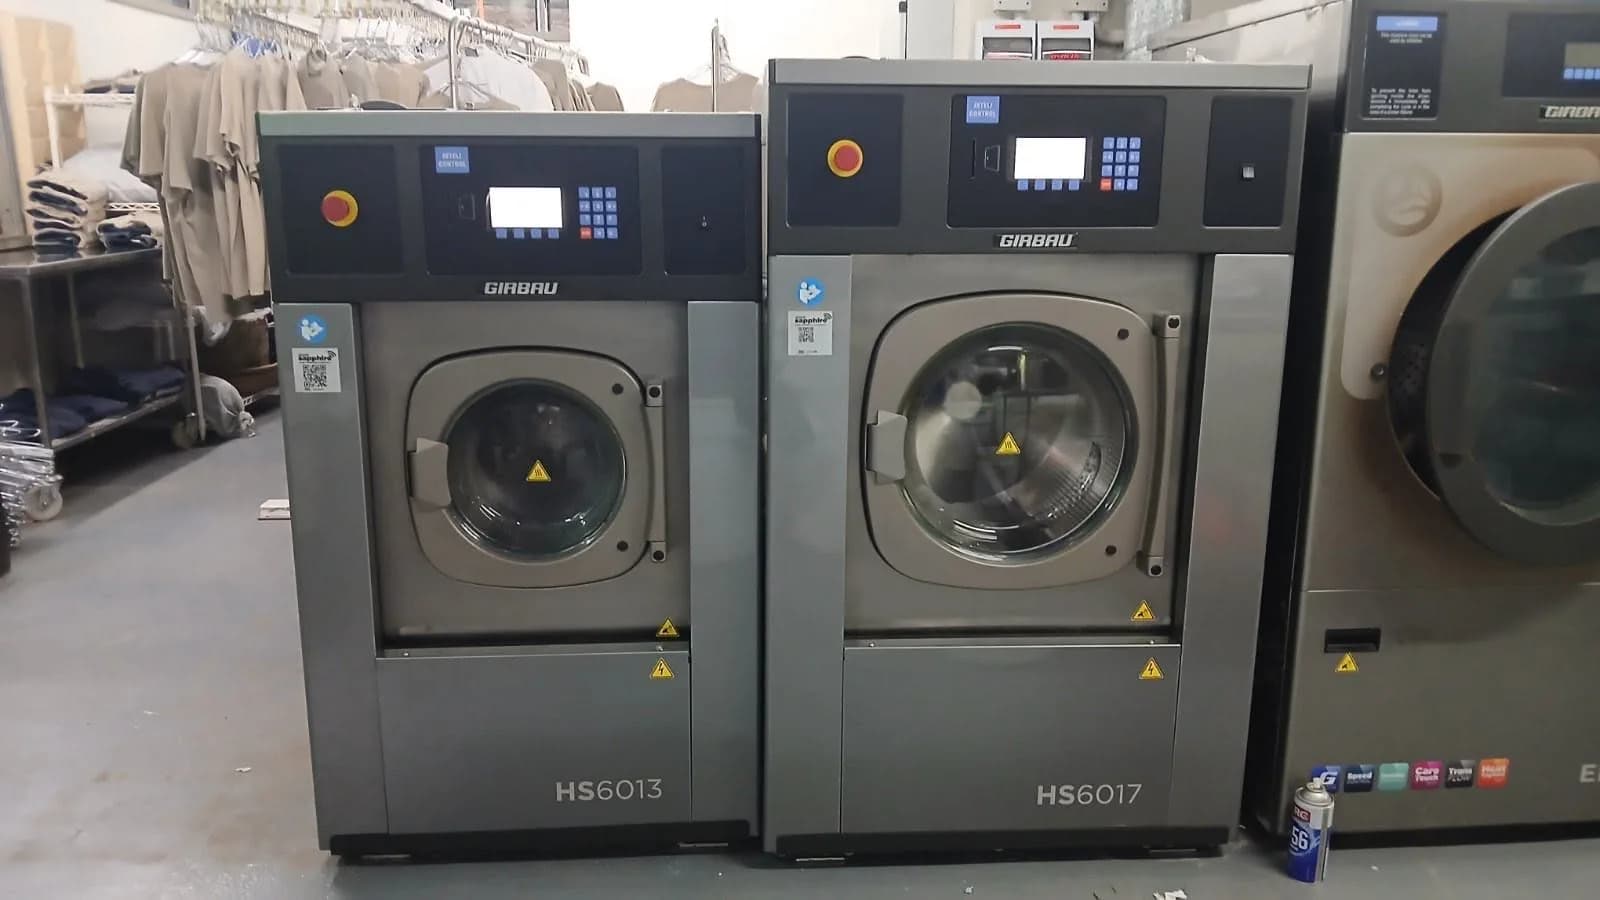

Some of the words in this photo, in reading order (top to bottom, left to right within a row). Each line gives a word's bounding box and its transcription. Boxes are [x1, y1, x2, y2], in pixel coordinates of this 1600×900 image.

[1000, 233, 1074, 248] GIRBAU
[484, 281, 559, 295] GIRBAU
[556, 779, 663, 801] HS6013
[1037, 784, 1142, 805] HS6017
[1291, 825, 1309, 850] 56
